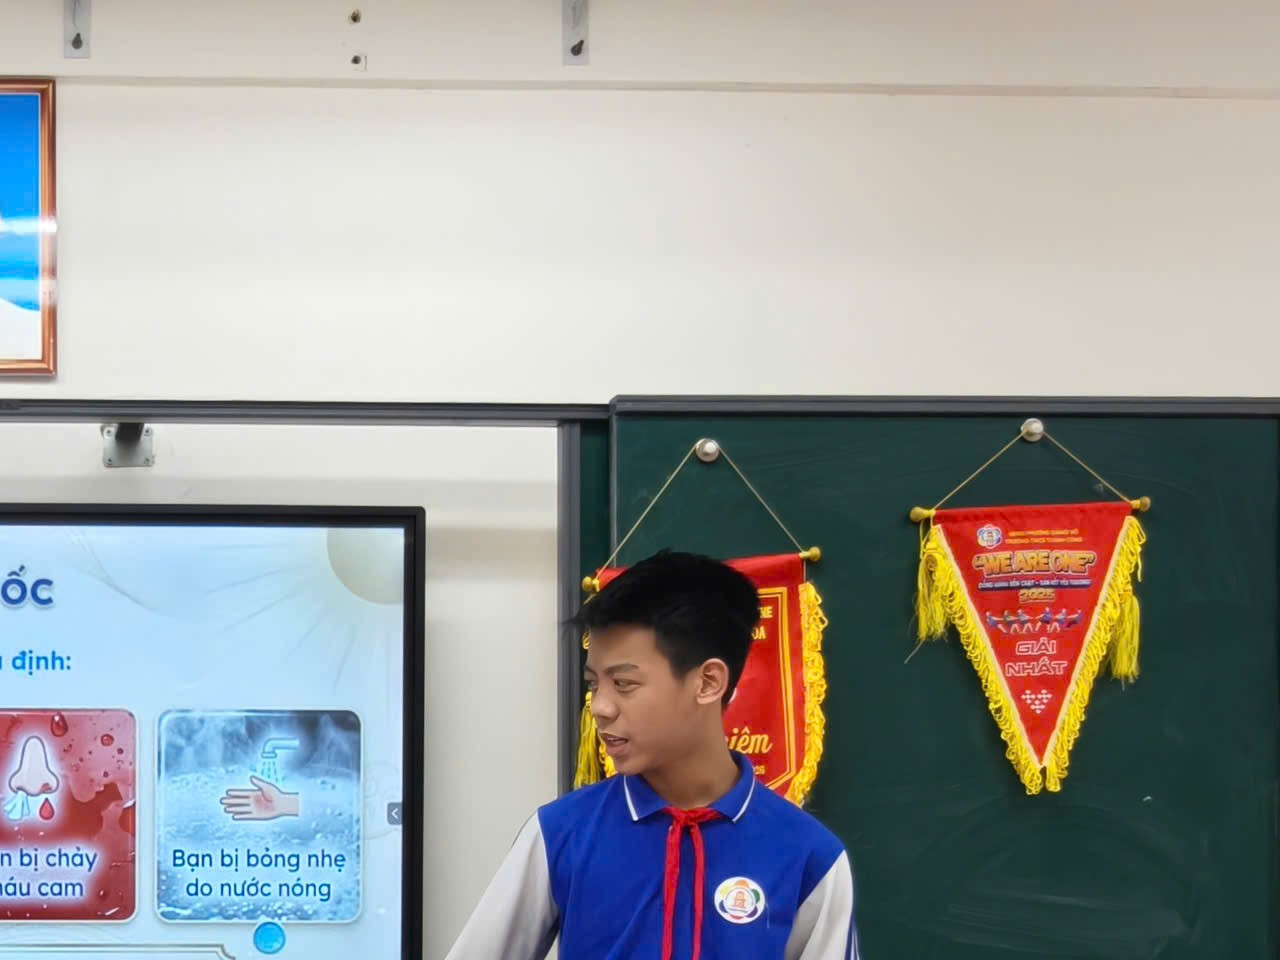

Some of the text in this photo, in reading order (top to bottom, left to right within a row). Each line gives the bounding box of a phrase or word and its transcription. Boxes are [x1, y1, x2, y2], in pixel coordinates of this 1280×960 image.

[1014, 550, 1050, 574] ARE
[1016, 637, 1057, 655] GIẢI
[11, 648, 71, 677] định:
[1005, 656, 1068, 676] NHẤT
[19, 847, 38, 872] bị
[45, 847, 97, 872] chảy
[172, 847, 346, 873] Bạn bị bỏng nhẹ
[37, 882, 84, 897] cam
[185, 877, 331, 903] do nước nóng
